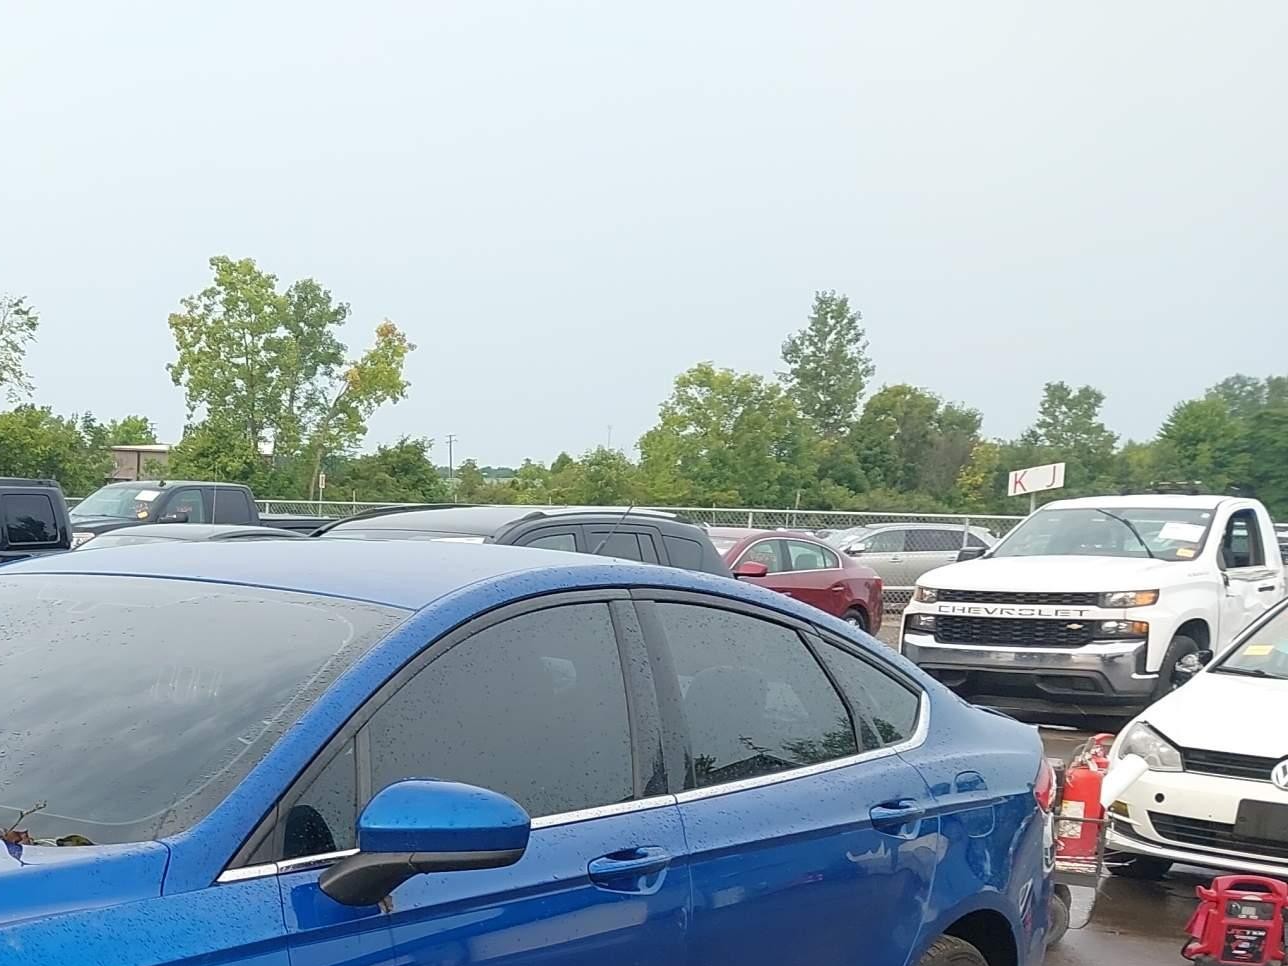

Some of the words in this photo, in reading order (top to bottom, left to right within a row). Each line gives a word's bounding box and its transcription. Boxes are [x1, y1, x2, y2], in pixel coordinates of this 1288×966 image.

[1013, 471, 1028, 494] K
[1046, 465, 1057, 488] J
[938, 604, 1090, 617] CHEVROLET
